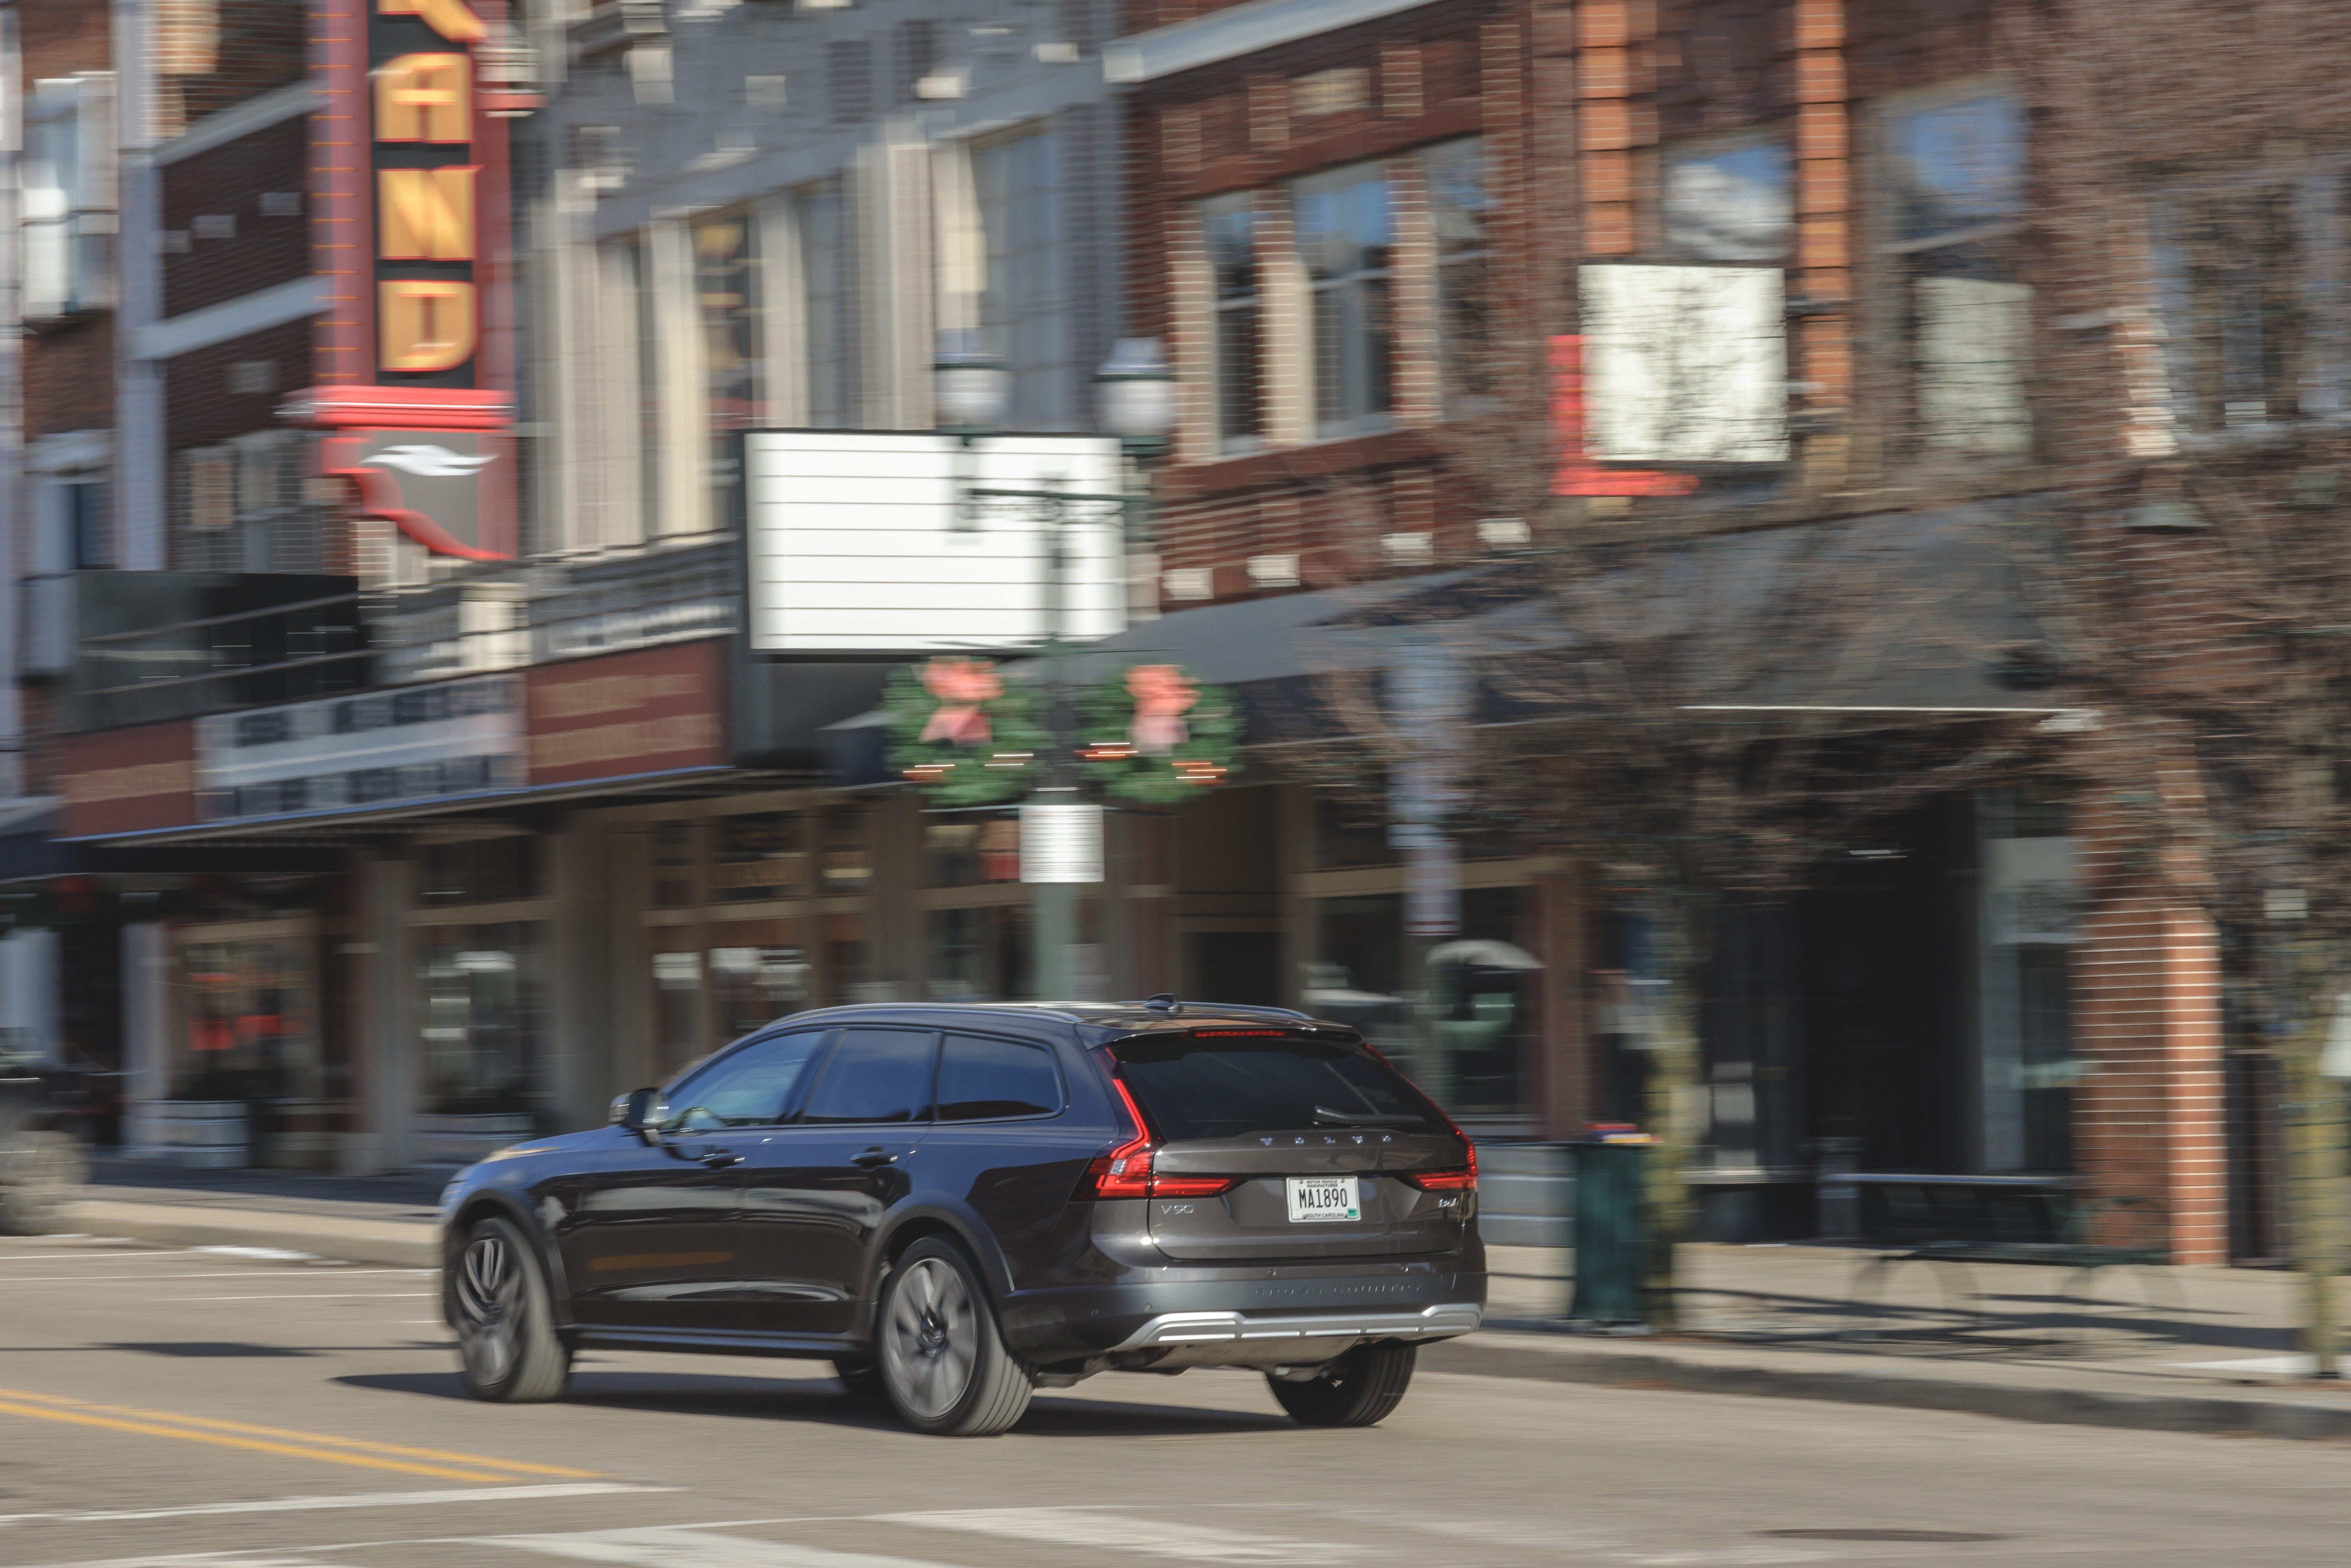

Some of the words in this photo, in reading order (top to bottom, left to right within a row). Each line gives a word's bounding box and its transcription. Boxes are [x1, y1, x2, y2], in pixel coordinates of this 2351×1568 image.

[1260, 1135, 1392, 1146] VOLVO
[1299, 1188, 1348, 1208] MA1890
[1161, 1204, 1194, 1214] V90
